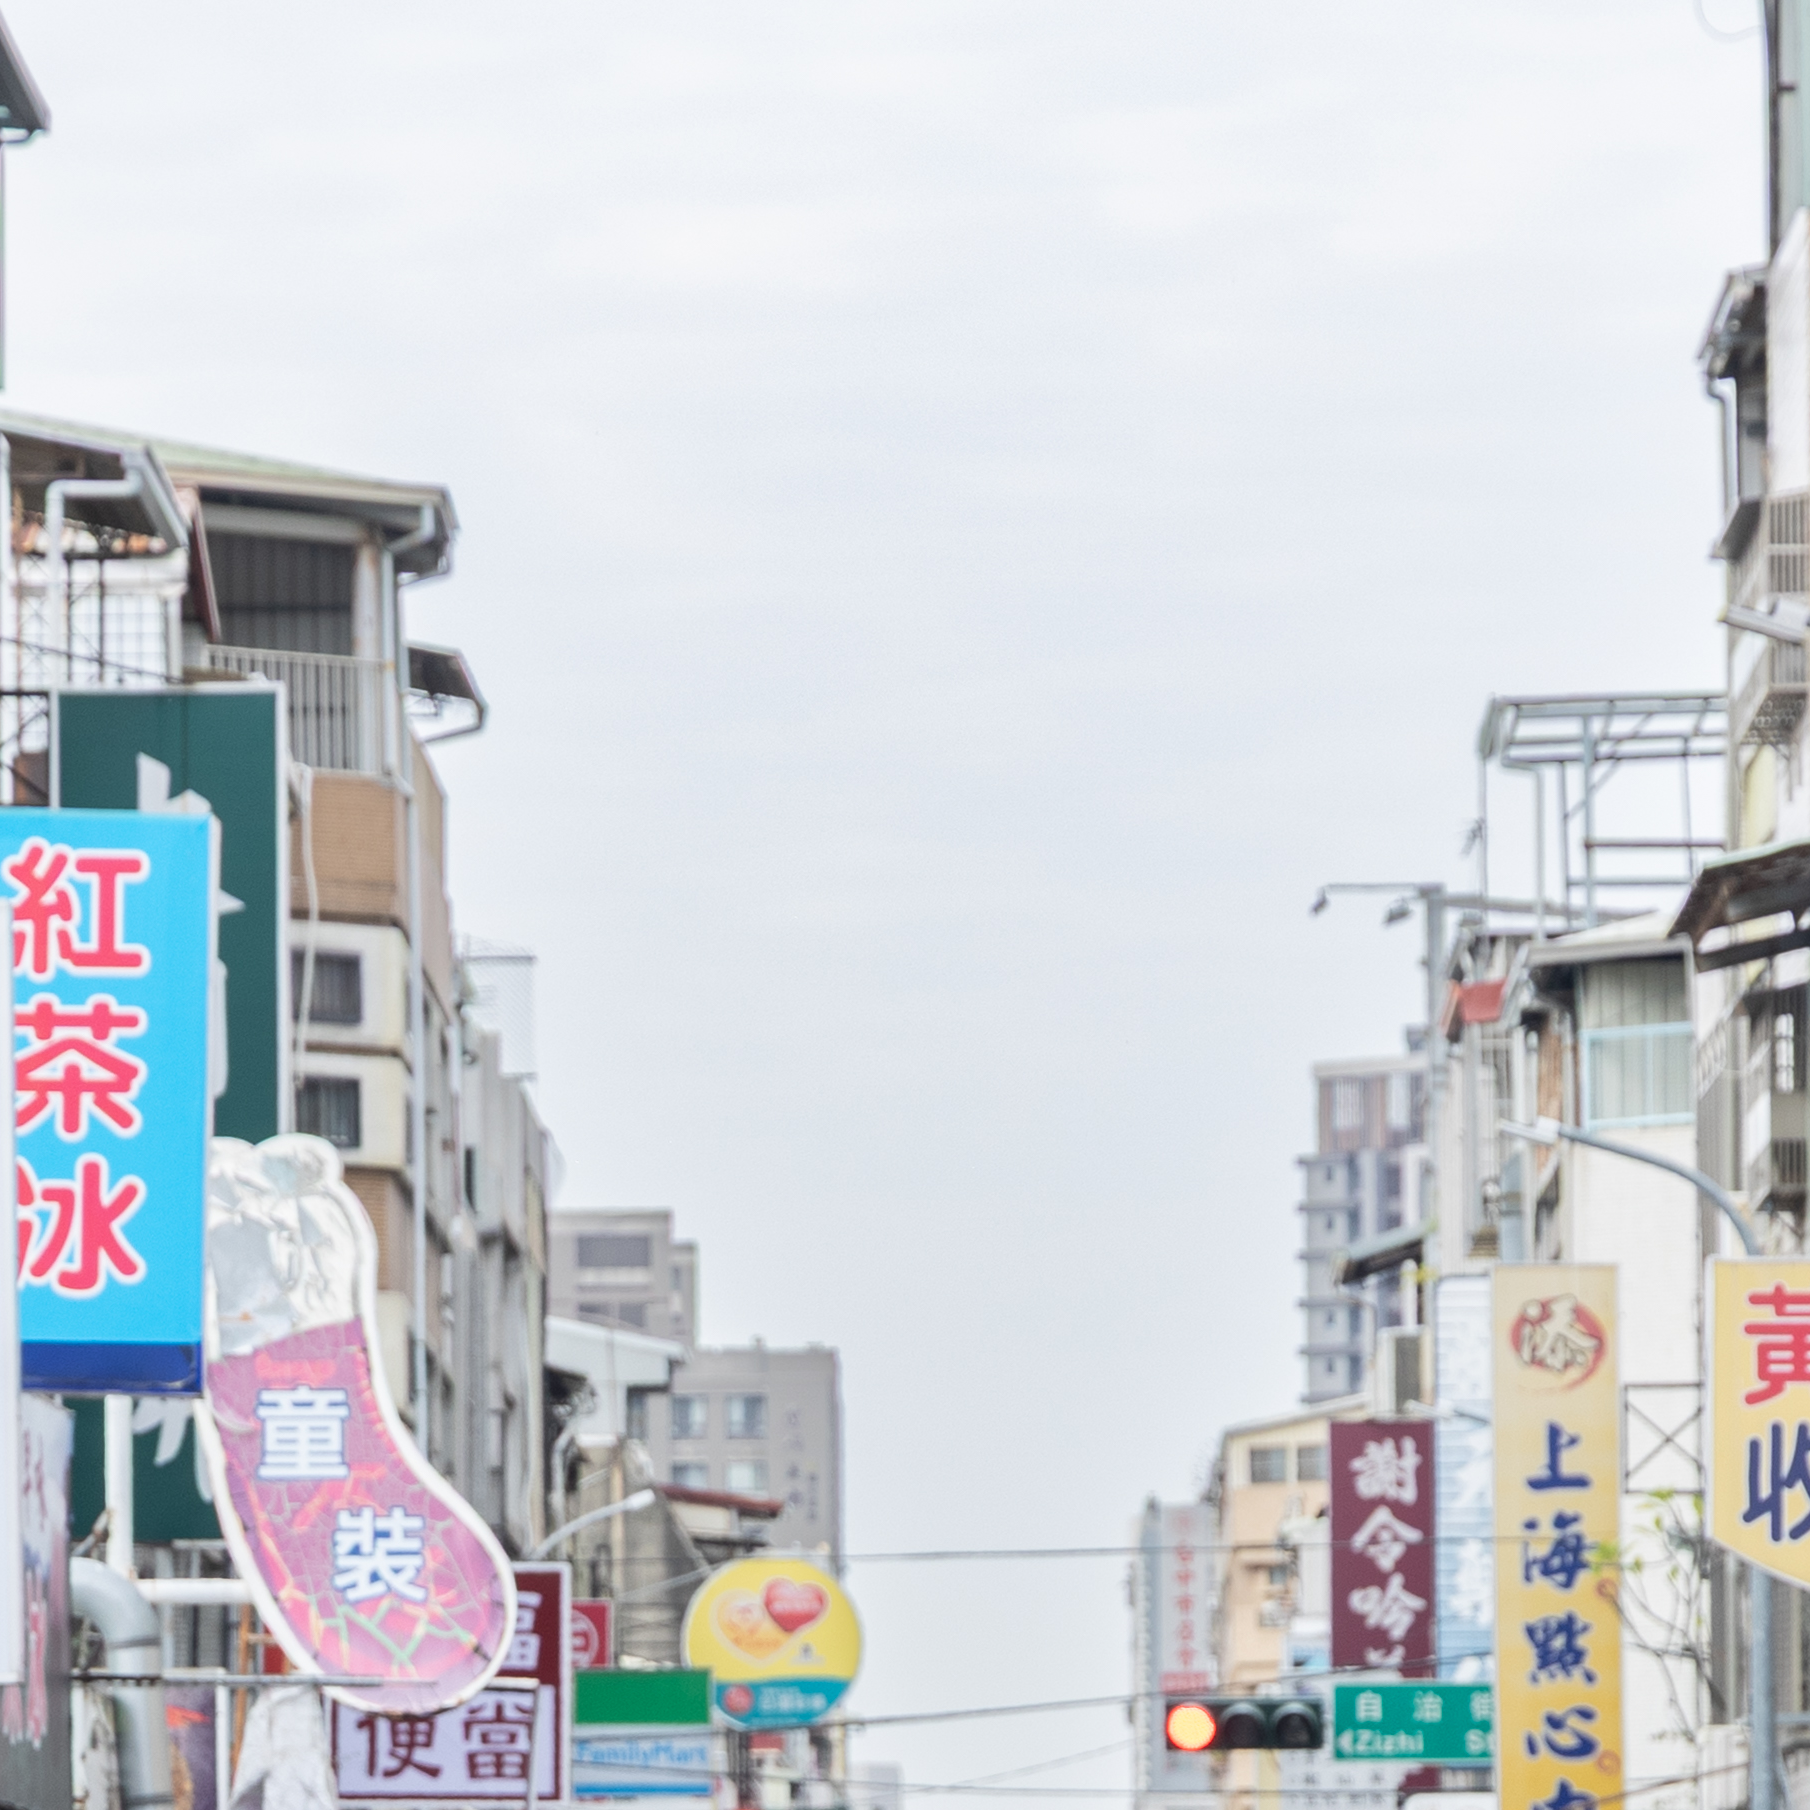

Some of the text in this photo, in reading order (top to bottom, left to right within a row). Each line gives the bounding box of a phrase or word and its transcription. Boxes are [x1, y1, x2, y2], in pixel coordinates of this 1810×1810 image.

[3, 838, 152, 1296] 紅茶冰
[254, 1384, 427, 1602] 童裝
[355, 1702, 534, 1781] 便當
[573, 1738, 709, 1768] FamilyMart
